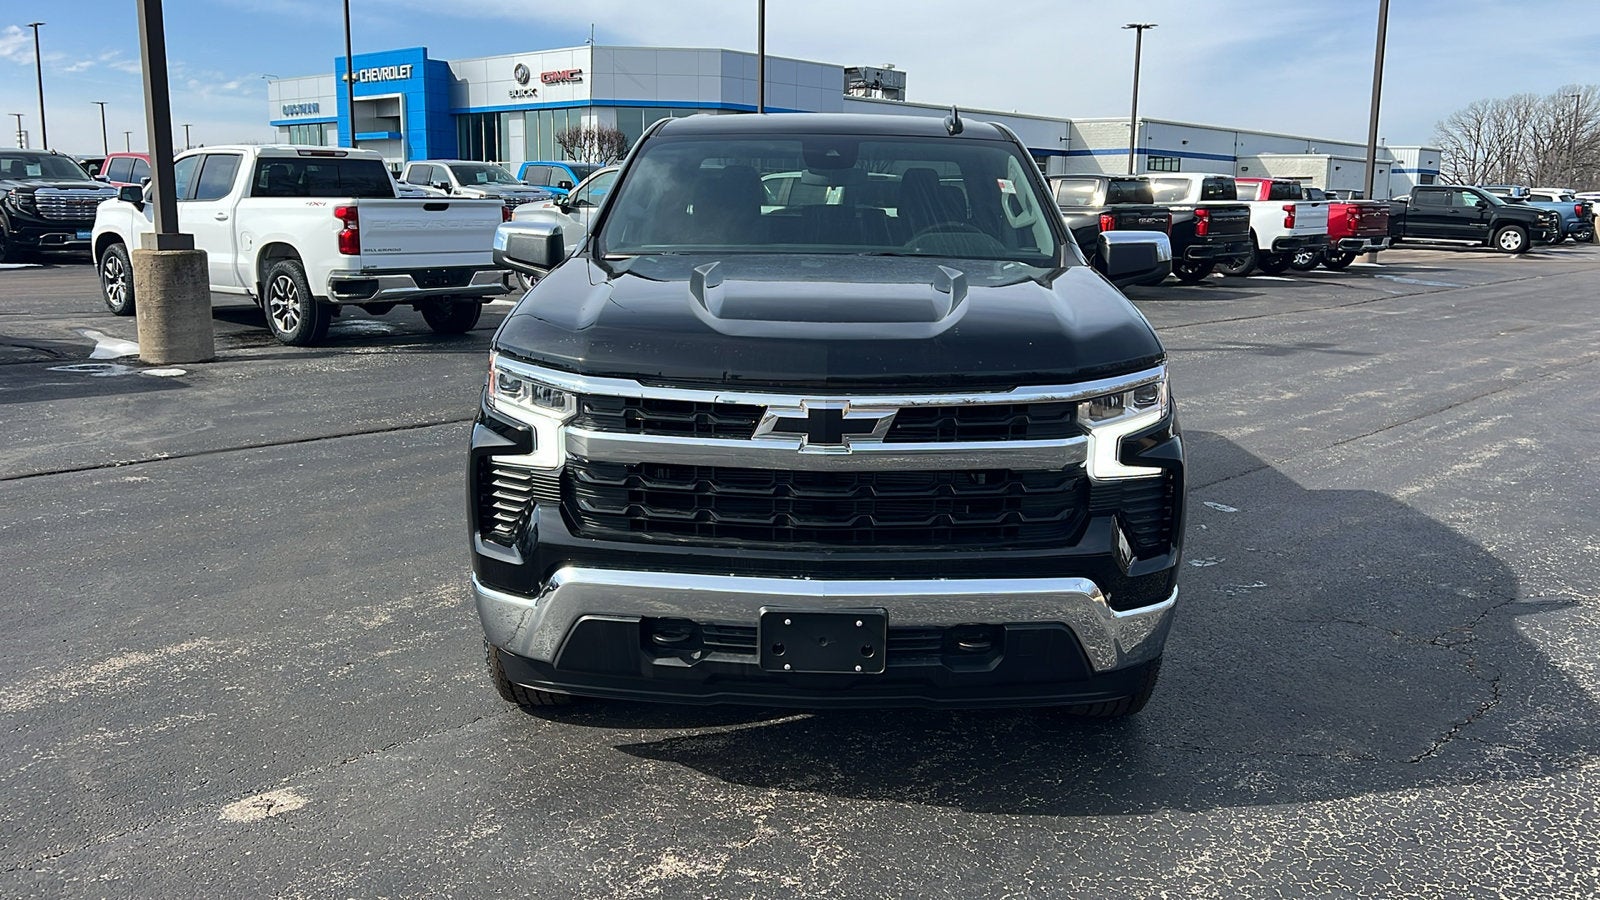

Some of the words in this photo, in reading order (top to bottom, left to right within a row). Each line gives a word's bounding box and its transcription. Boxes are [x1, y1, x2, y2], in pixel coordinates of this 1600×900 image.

[360, 64, 413, 83] CHEVROLET
[541, 68, 583, 84] GMC
[509, 88, 538, 98] BUICK
